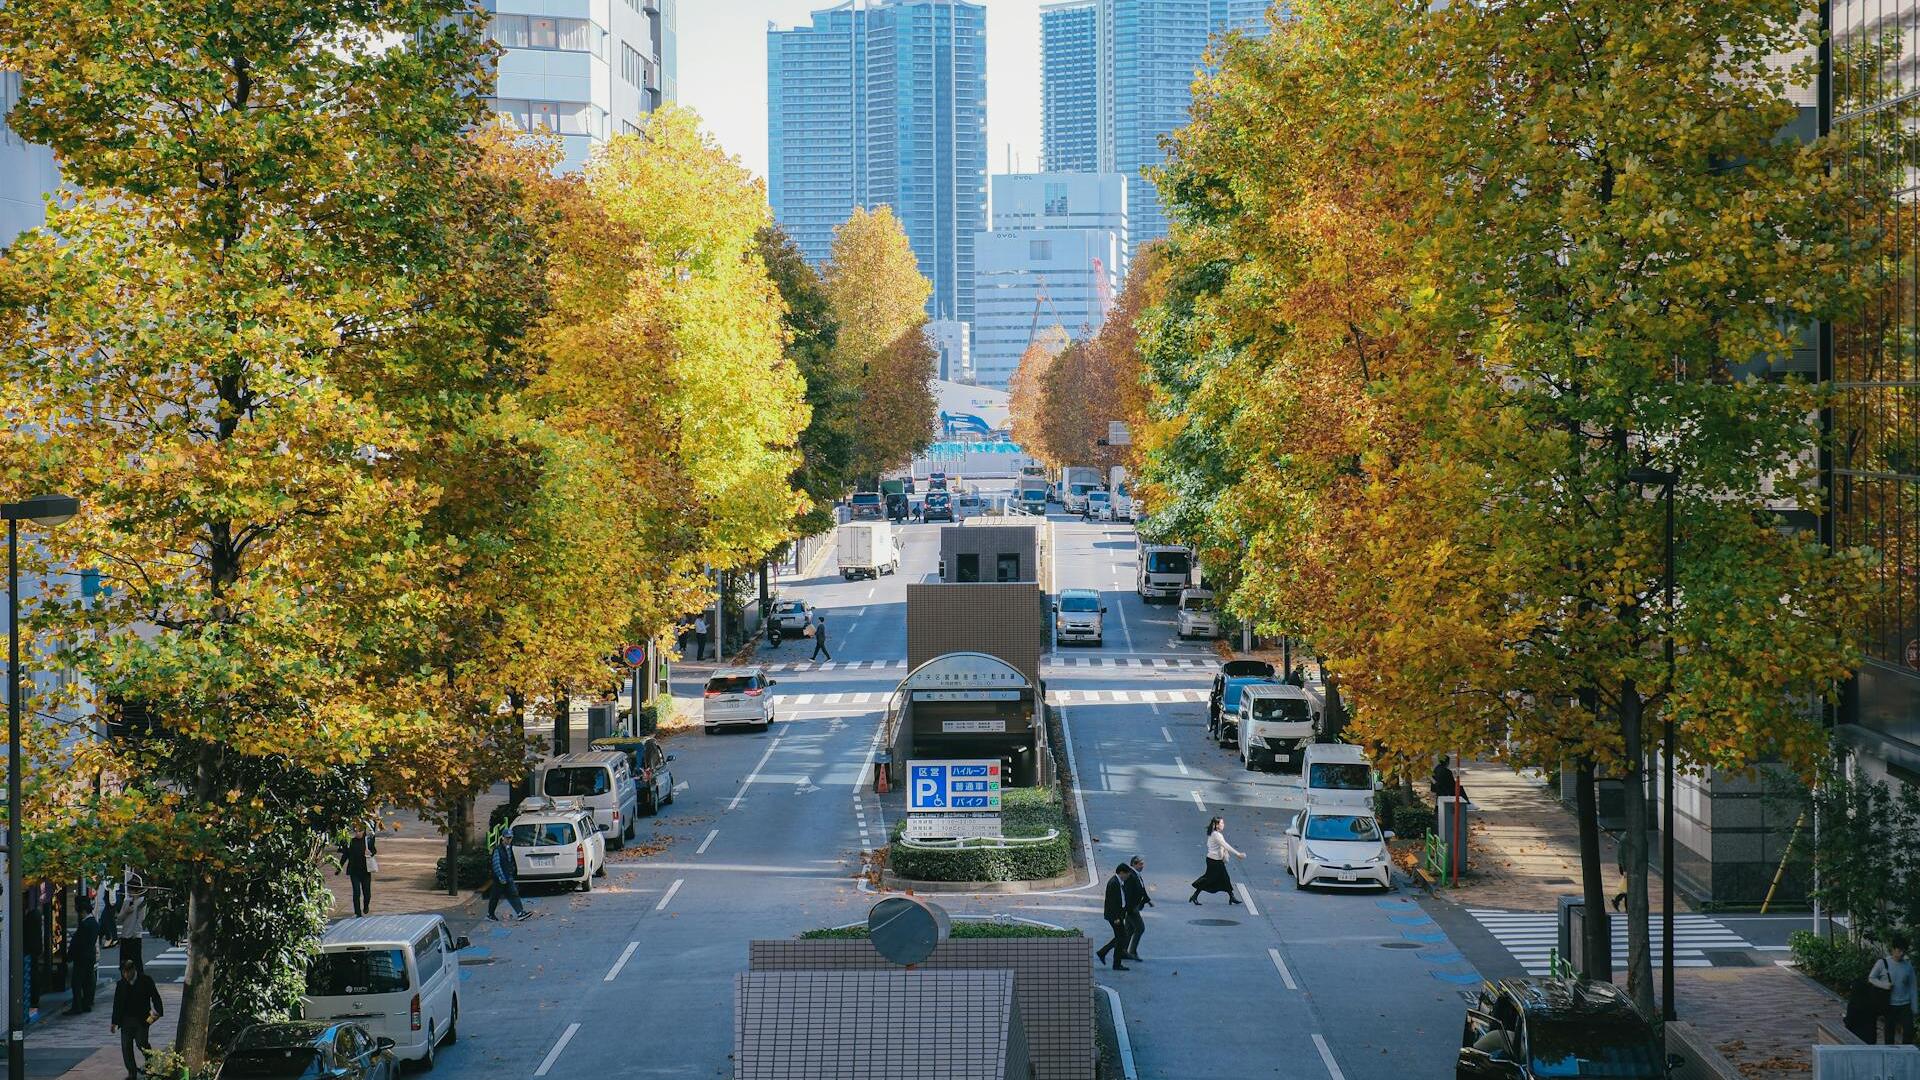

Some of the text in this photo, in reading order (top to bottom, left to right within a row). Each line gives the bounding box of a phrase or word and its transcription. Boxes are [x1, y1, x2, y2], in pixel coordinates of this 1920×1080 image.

[952, 767, 986, 775] ハイルーフ
[917, 779, 937, 806] P
[956, 798, 983, 806] バイク
